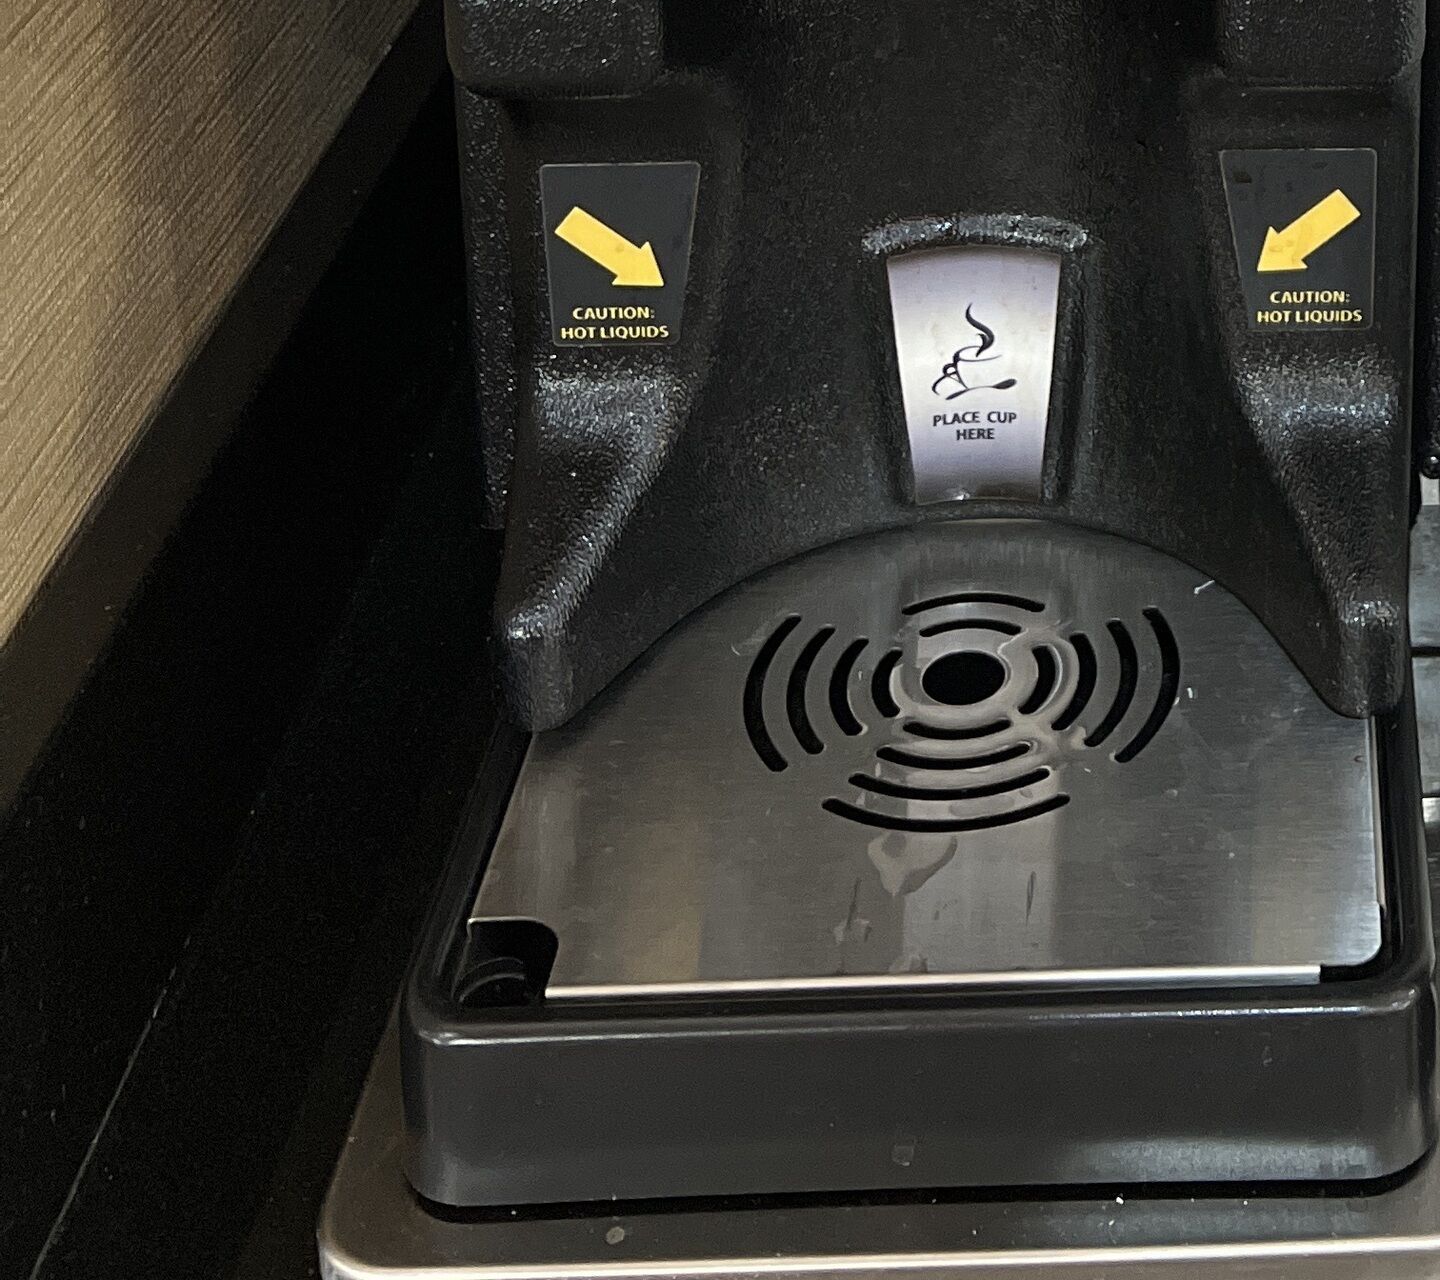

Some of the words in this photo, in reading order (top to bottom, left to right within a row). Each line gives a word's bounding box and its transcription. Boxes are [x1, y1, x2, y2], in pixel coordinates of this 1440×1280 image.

[1269, 290, 1350, 304] CAUTION:
[572, 306, 656, 320] CAUTION:
[1256, 310, 1292, 323] HOT
[1295, 309, 1363, 323] LIQUIDS
[561, 326, 597, 339] HOT
[600, 325, 670, 339] LIQUIDS
[932, 411, 981, 427] PLACE
[987, 411, 1017, 424] CUP
[955, 427, 996, 441] HERE
